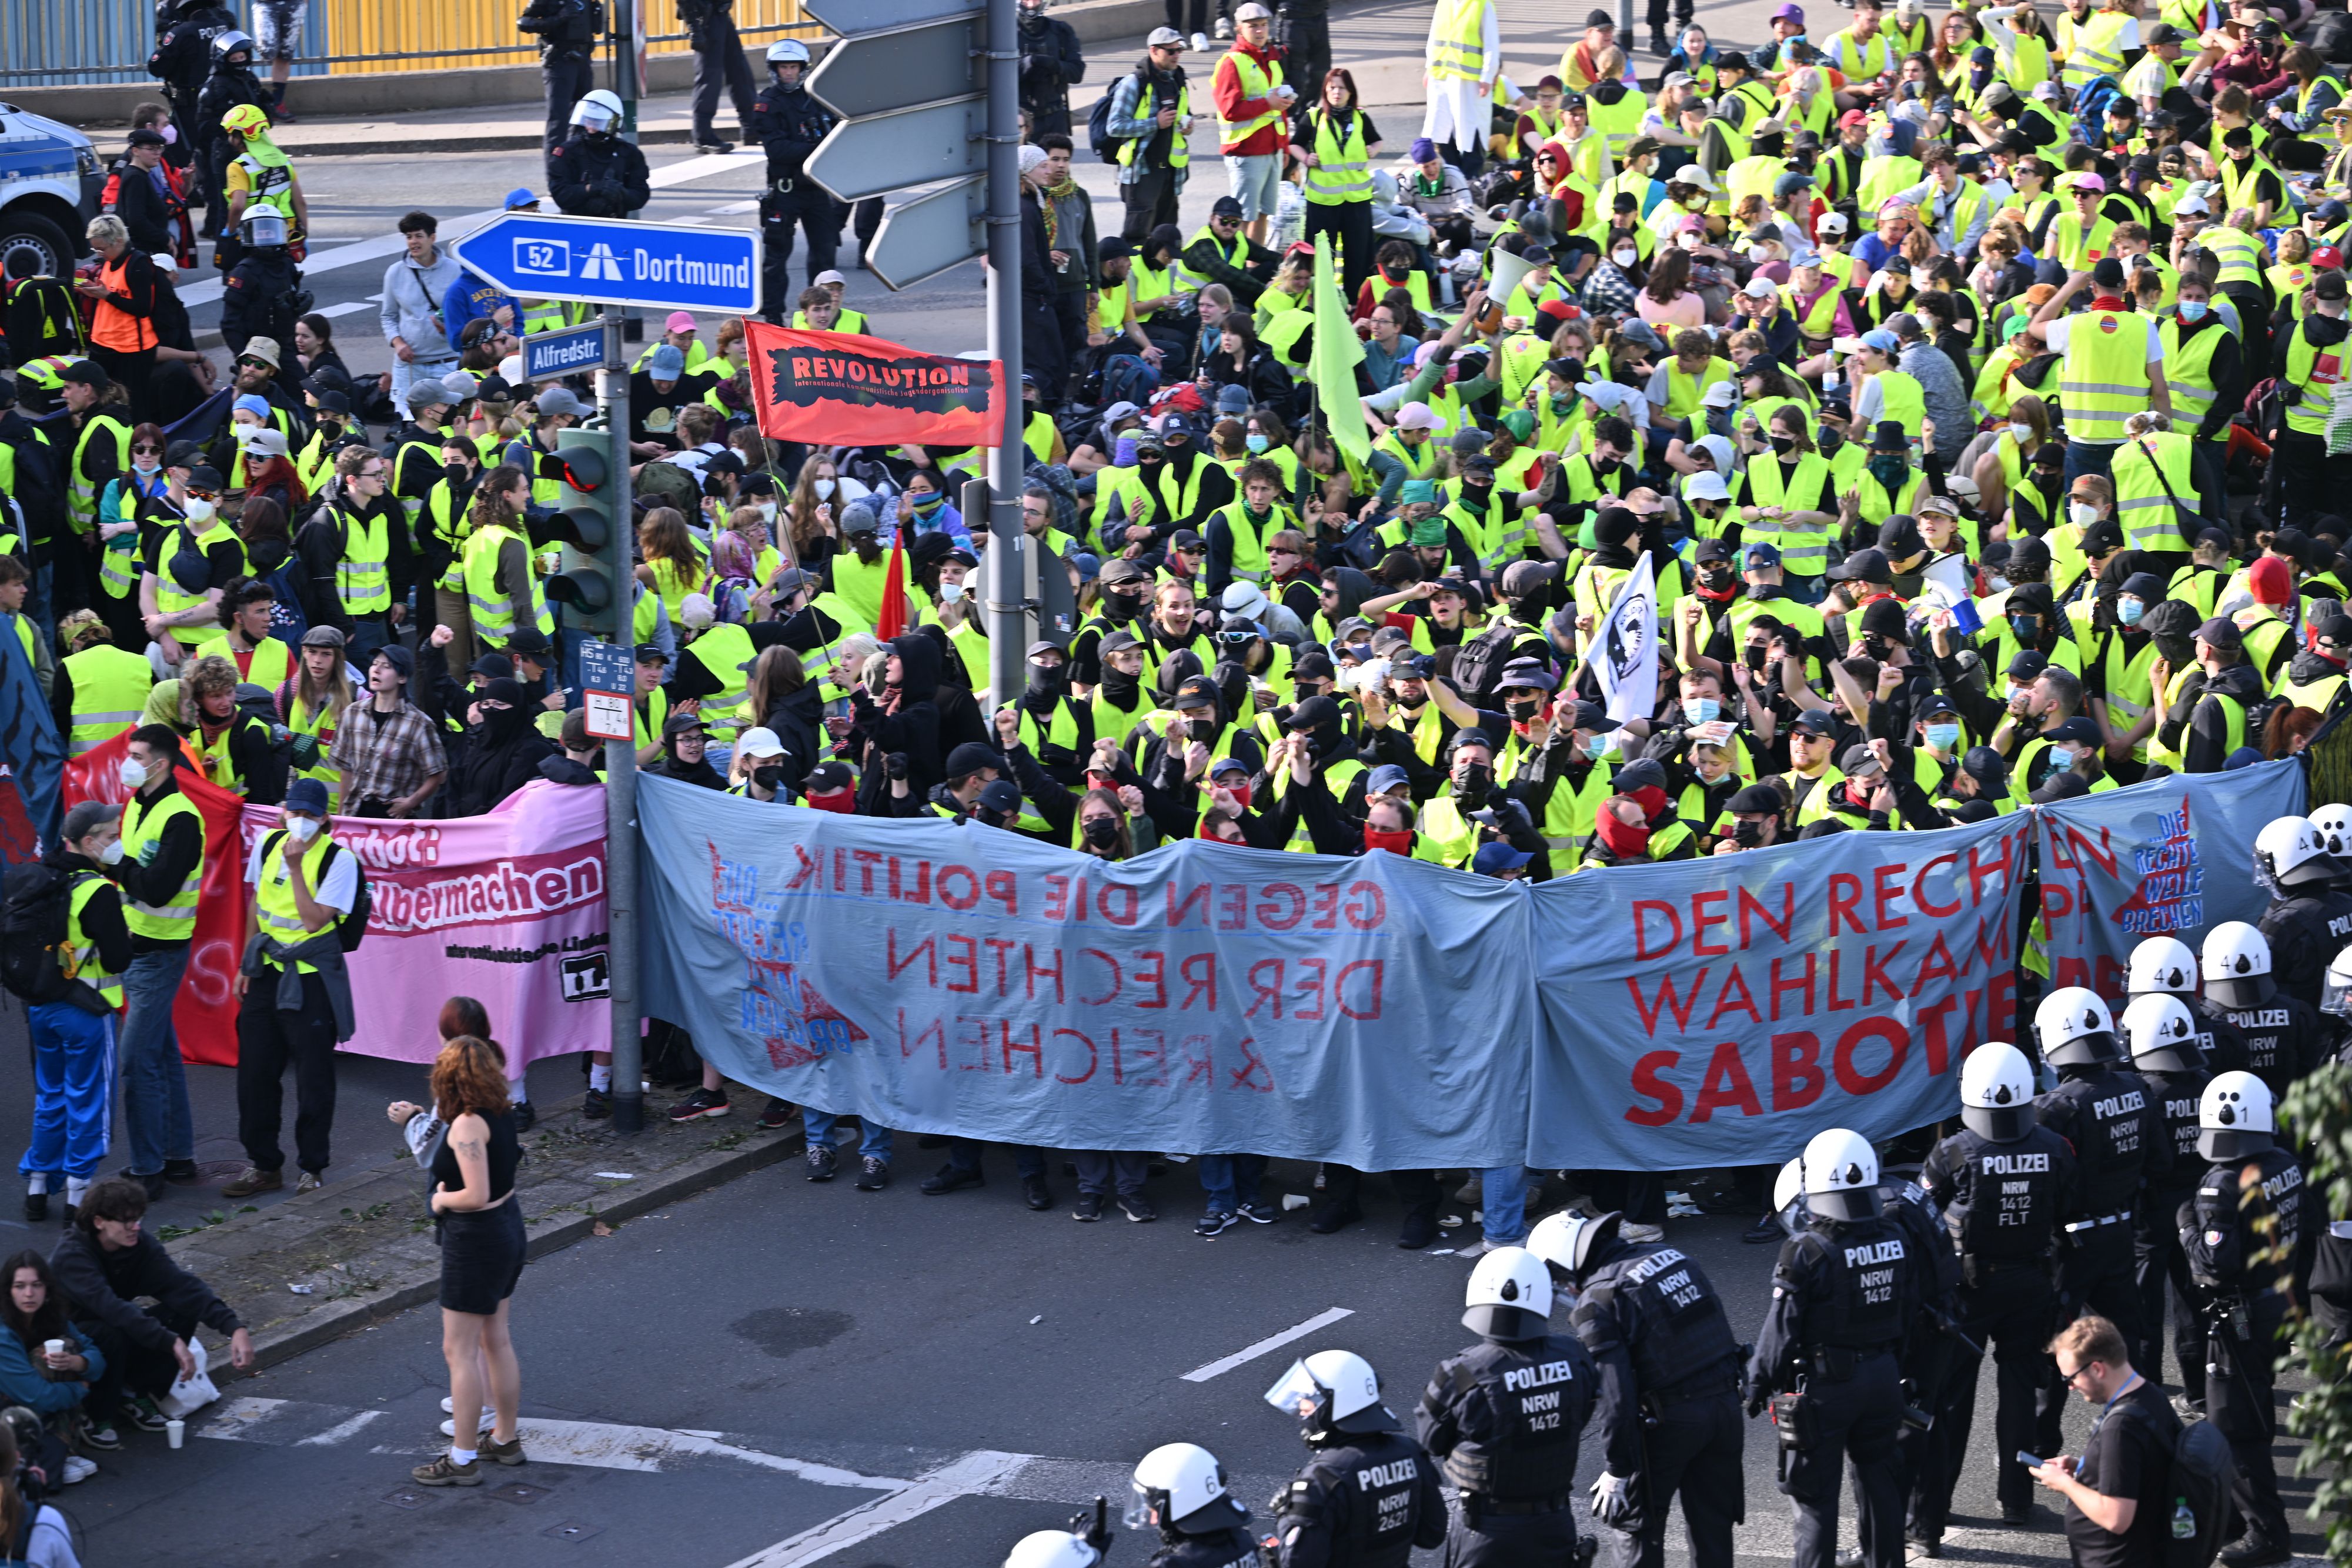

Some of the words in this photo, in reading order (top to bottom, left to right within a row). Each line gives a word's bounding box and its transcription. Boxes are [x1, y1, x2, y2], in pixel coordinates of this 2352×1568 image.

[529, 246, 554, 269] 52
[634, 248, 749, 289] Dortmund
[534, 339, 600, 370] Alfredstr.
[792, 357, 968, 388] REVOLUTION
[847, 383, 898, 396] kommunistische
[595, 696, 602, 706] H
[2299, 837, 2310, 851] 4
[2135, 838, 2200, 874] RECHTE
[2146, 868, 2205, 904] WELLE
[1632, 882, 1795, 962] DEN
[2122, 900, 2203, 933] BRECHEN
[2220, 955, 2230, 970] 4
[2253, 953, 2261, 969] 1
[2154, 968, 2165, 984] 4
[2185, 969, 2191, 985] 1
[2063, 1017, 2073, 1032] 4
[2227, 1009, 2290, 1029] POLIZEI
[2159, 1022, 2171, 1038] 4
[1982, 1087, 1992, 1102] 4
[2013, 1084, 2020, 1099] 1
[2093, 1091, 2146, 1120] POLIZEI
[2240, 1106, 2248, 1123] 1
[2110, 1118, 2140, 1139] NRW
[2114, 1136, 2139, 1154] 1412
[1982, 1153, 2050, 1175] POLIZEI
[1829, 1168, 1840, 1185] 4
[1865, 1165, 1872, 1181] 1
[2261, 1165, 2303, 1201] POLIZEI
[2002, 1181, 2030, 1194] NRW
[2000, 1196, 2032, 1211] 1412
[2277, 1193, 2299, 1215] NRW
[1999, 1211, 2030, 1226] FLT
[1844, 1239, 1905, 1268] POLIZEI
[1626, 1249, 1686, 1284] POLIZEI
[1657, 1269, 1691, 1296] NRW
[1860, 1268, 1894, 1288] NRW
[1525, 1284, 1532, 1301] 1
[1672, 1285, 1702, 1308] 1412
[1864, 1286, 1892, 1305] 1412
[1504, 1360, 1573, 1392] POLIZEI
[1365, 1378, 1375, 1396] 6
[1522, 1391, 1560, 1414] NRW
[1529, 1412, 1561, 1432] 1412
[1357, 1458, 1418, 1492] POLIZEI
[1205, 1476, 1217, 1495] 6
[1378, 1489, 1410, 1514] NRW
[1378, 1509, 1408, 1532] 2621
